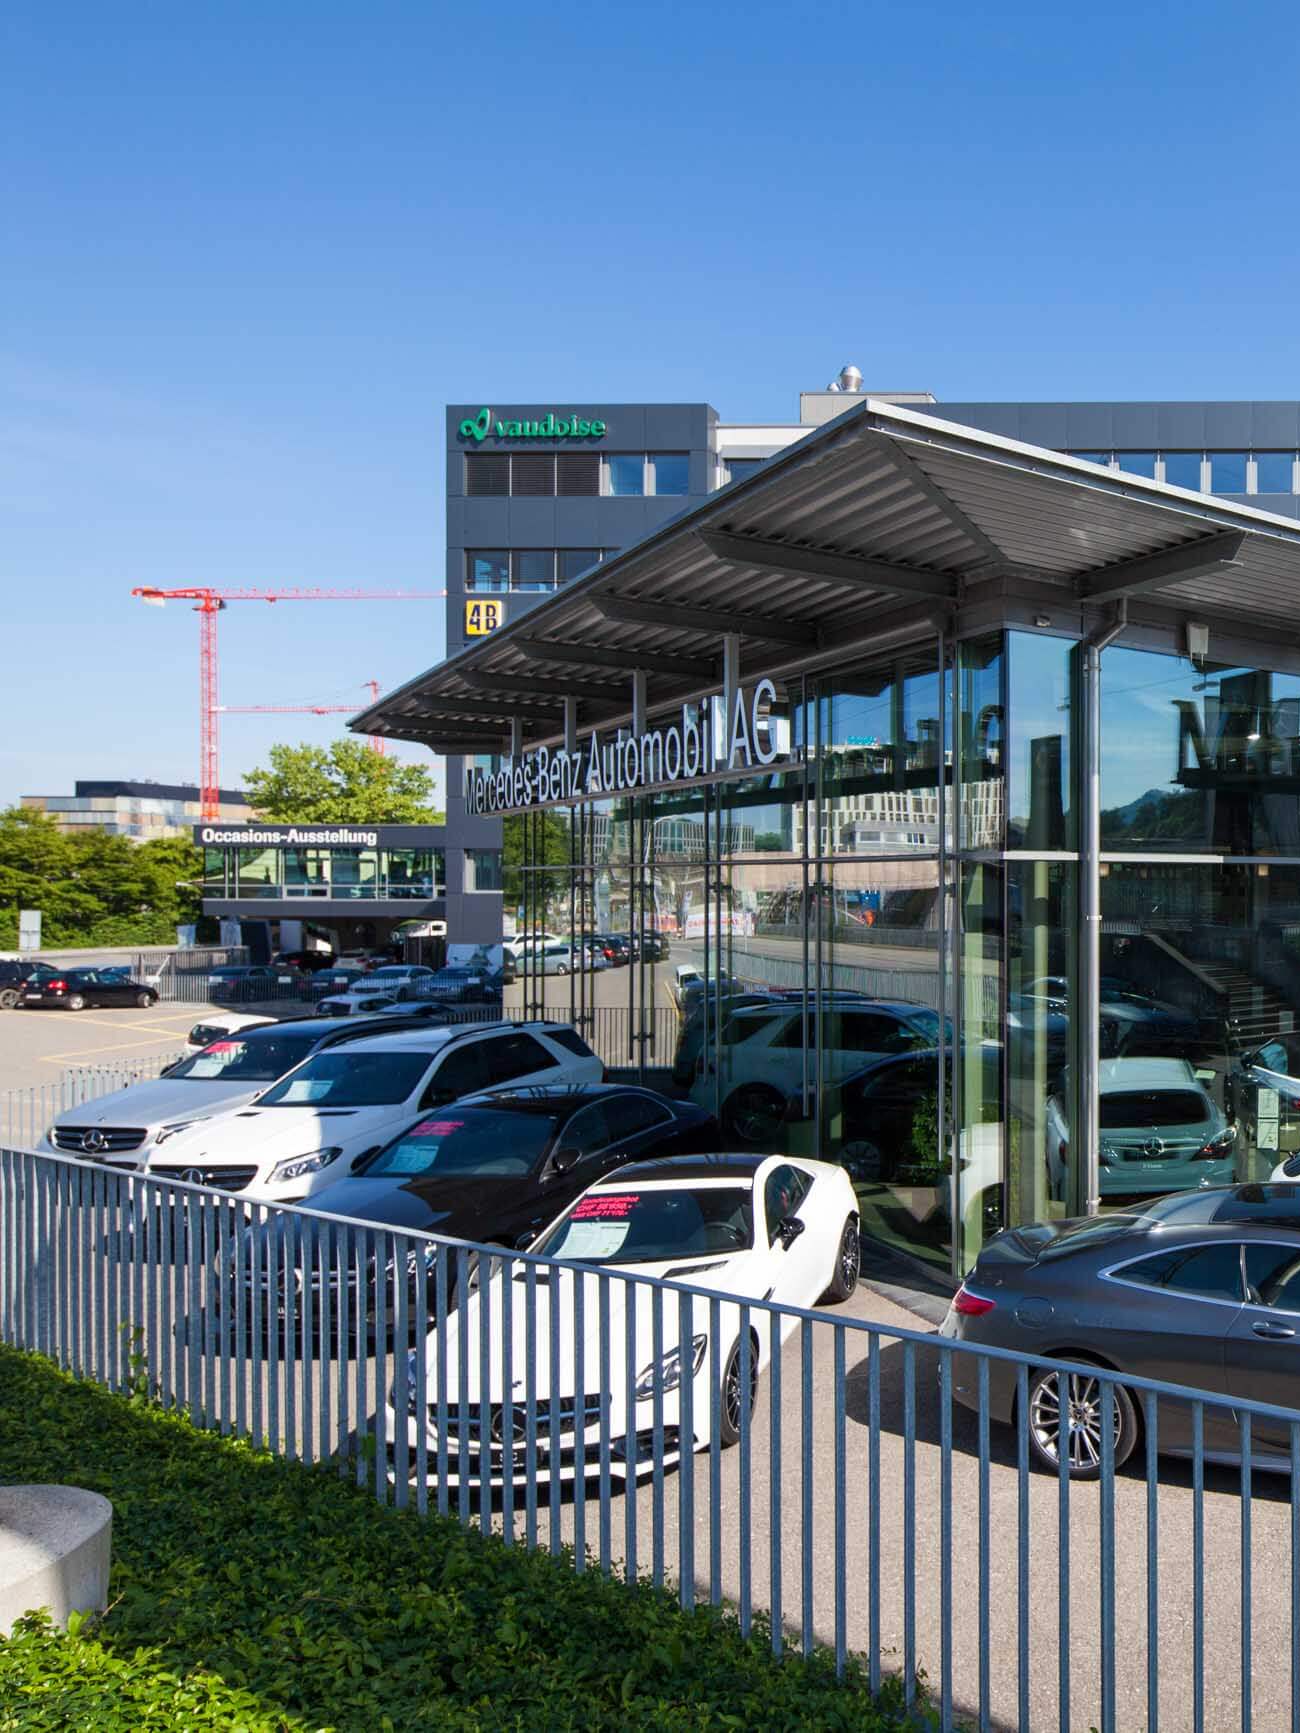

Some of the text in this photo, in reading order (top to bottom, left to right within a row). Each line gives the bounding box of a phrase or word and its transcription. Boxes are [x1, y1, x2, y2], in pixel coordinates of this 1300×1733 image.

[496, 413, 606, 437] vaudoise
[469, 604, 497, 631] 4B
[463, 678, 784, 815] Mercedes-Benz Automobil AG
[202, 828, 378, 846] Occasions-Ausstellung
